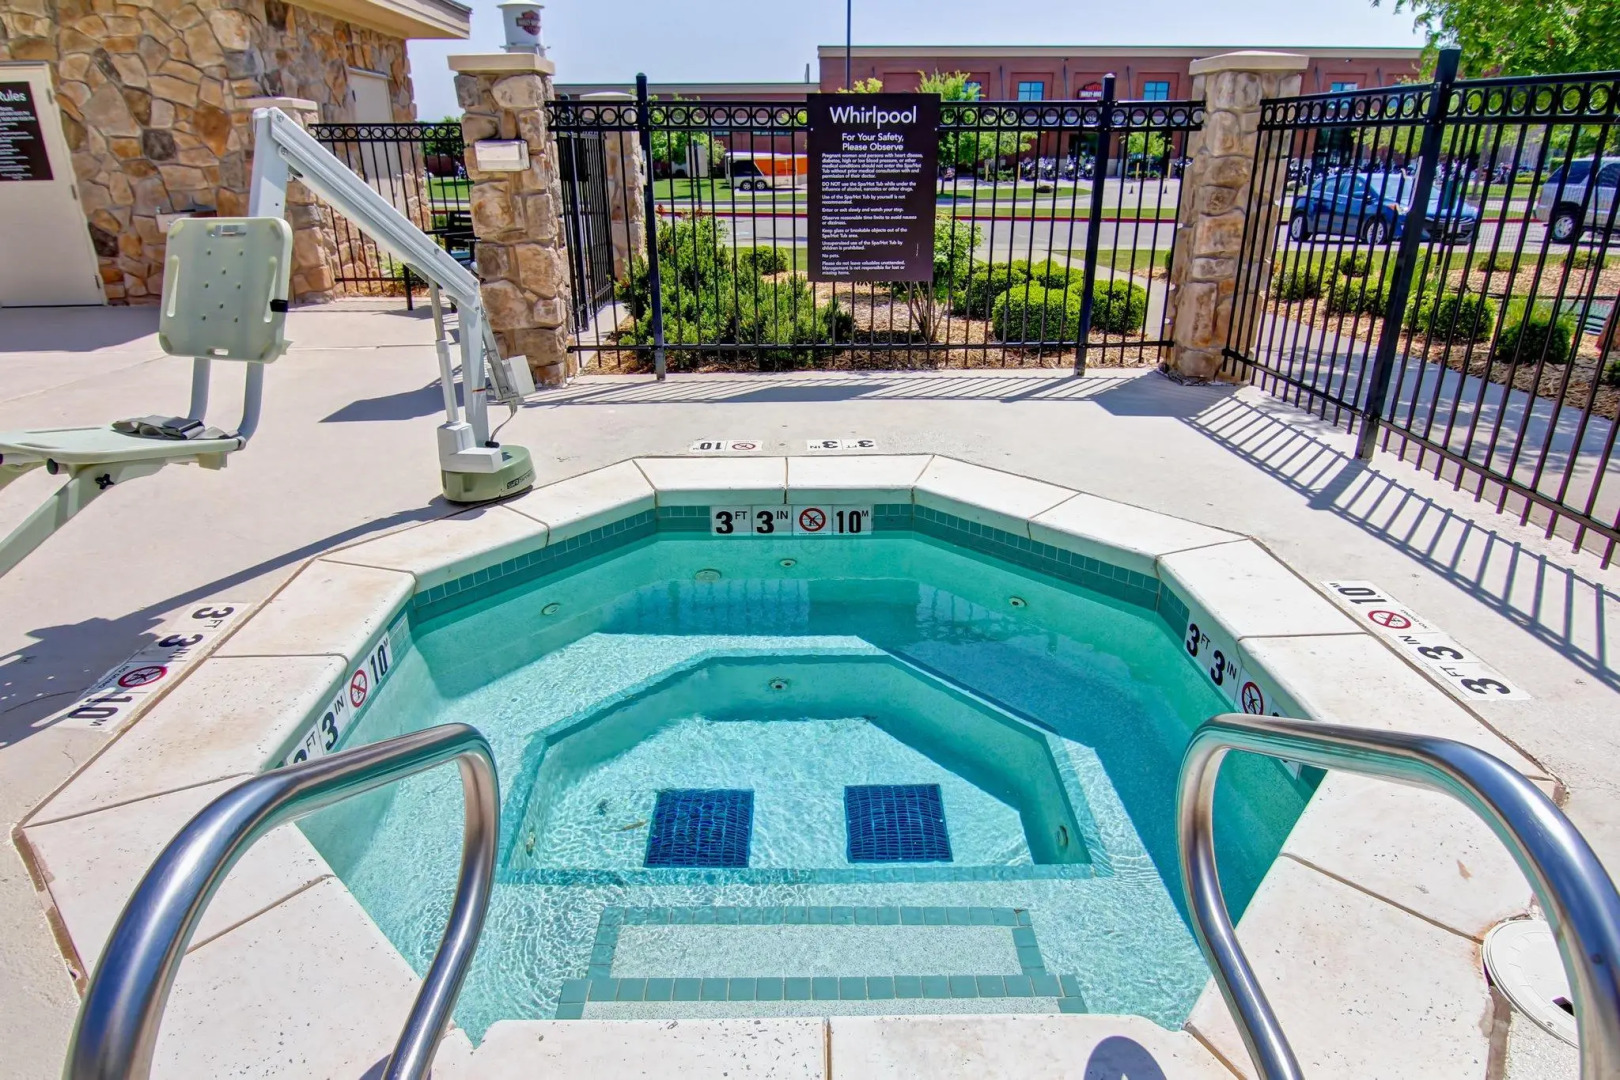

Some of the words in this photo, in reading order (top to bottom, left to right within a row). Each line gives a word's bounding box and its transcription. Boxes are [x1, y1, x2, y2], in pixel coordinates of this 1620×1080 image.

[829, 105, 917, 130] Whirlpool
[842, 133, 855, 141] For
[857, 133, 875, 141] Your
[877, 132, 904, 143] Safety,
[842, 143, 867, 151] Please
[869, 143, 904, 151] Observe
[822, 440, 839, 449] 3
[857, 440, 875, 448] 3
[715, 510, 734, 534] 3
[734, 511, 747, 520] FT
[756, 510, 774, 534] 3
[776, 511, 788, 519] IN
[191, 606, 235, 620] 3
[158, 634, 204, 648] 3
[1186, 623, 1200, 657] 3
[1200, 633, 1211, 650] FT
[1210, 650, 1225, 686] 3
[1226, 661, 1237, 680] IN
[1417, 645, 1464, 660] 3
[1440, 666, 1465, 677] FT
[1461, 678, 1511, 695] 3
[306, 731, 317, 752] FT
[322, 712, 338, 751] 3
[334, 695, 345, 715] IN
